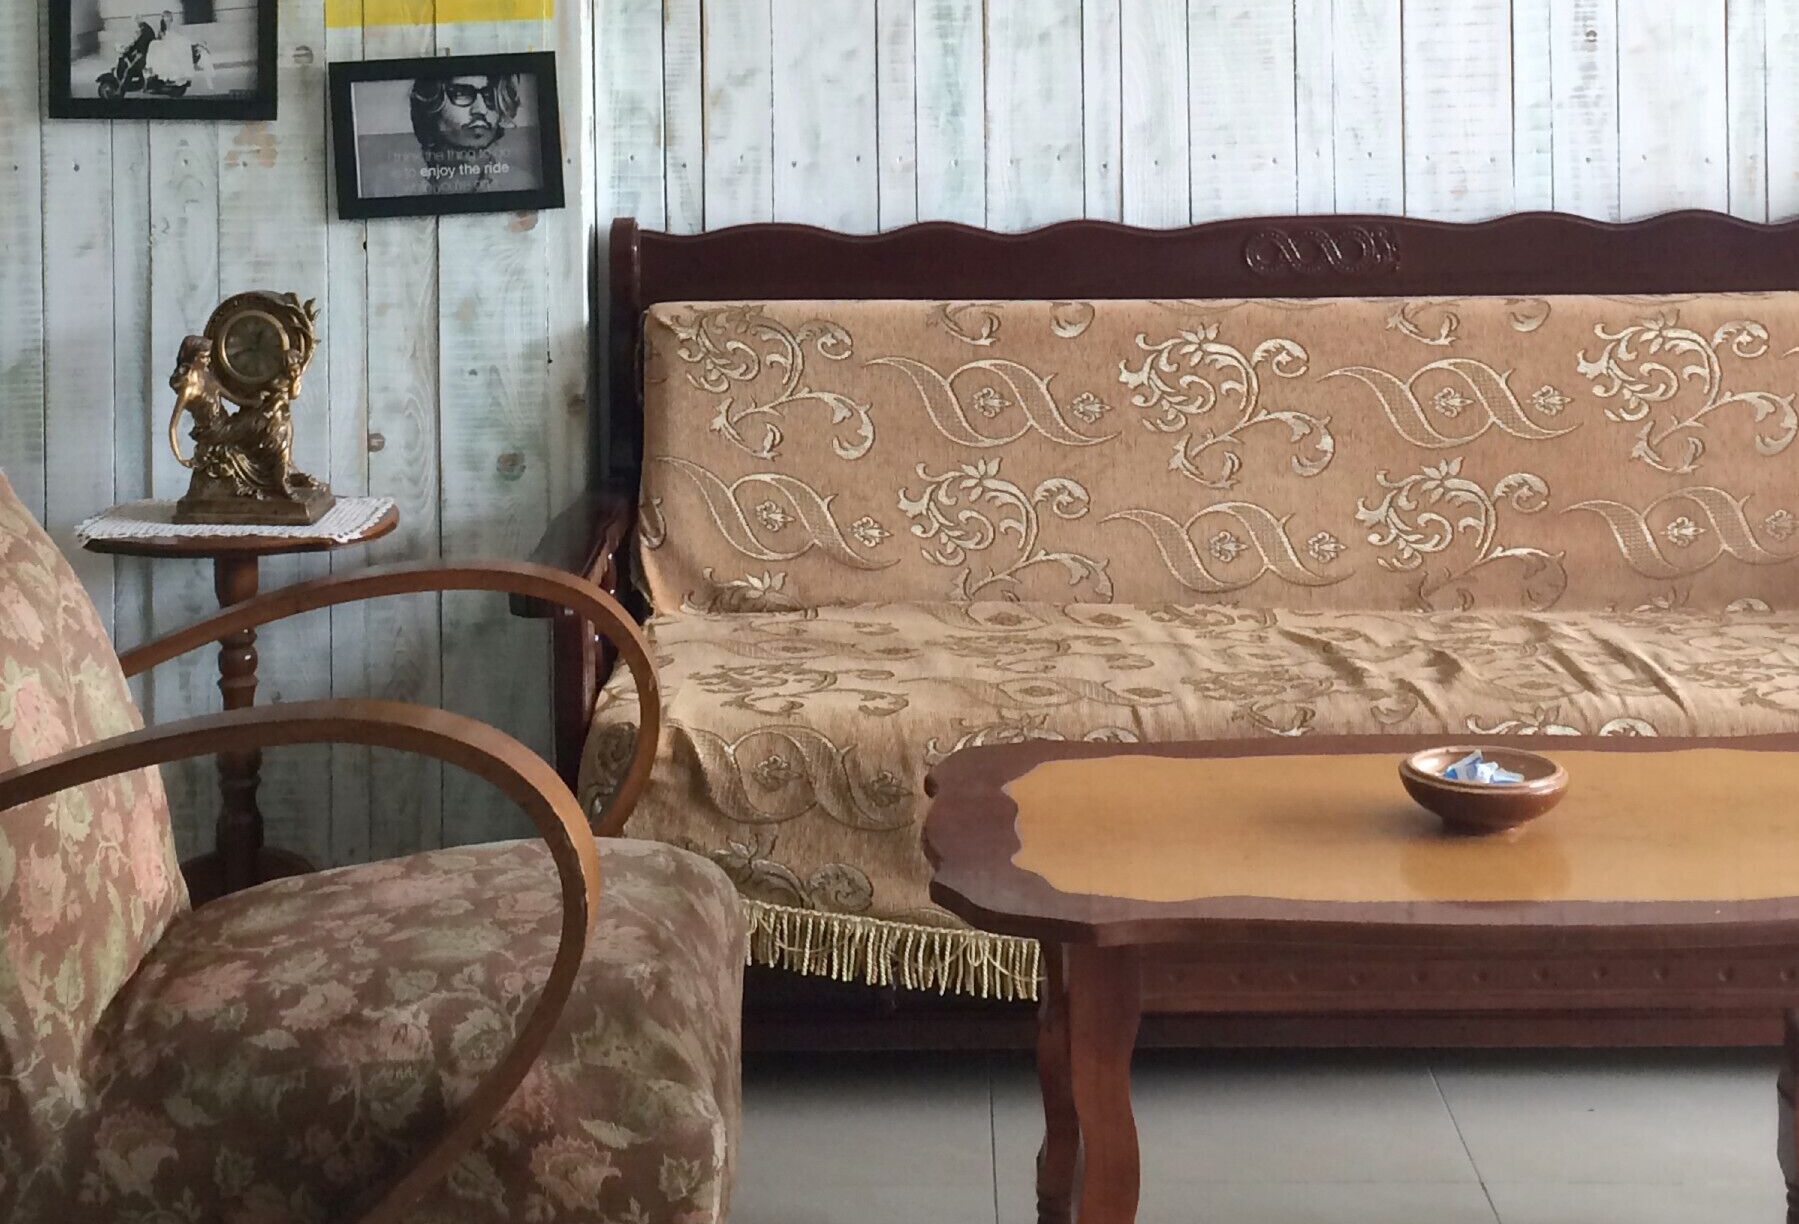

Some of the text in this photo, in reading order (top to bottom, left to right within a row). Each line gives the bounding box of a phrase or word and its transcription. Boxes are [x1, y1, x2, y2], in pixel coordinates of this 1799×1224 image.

[420, 164, 456, 179] enjoy
[459, 162, 480, 175] the
[484, 161, 510, 174] ride
